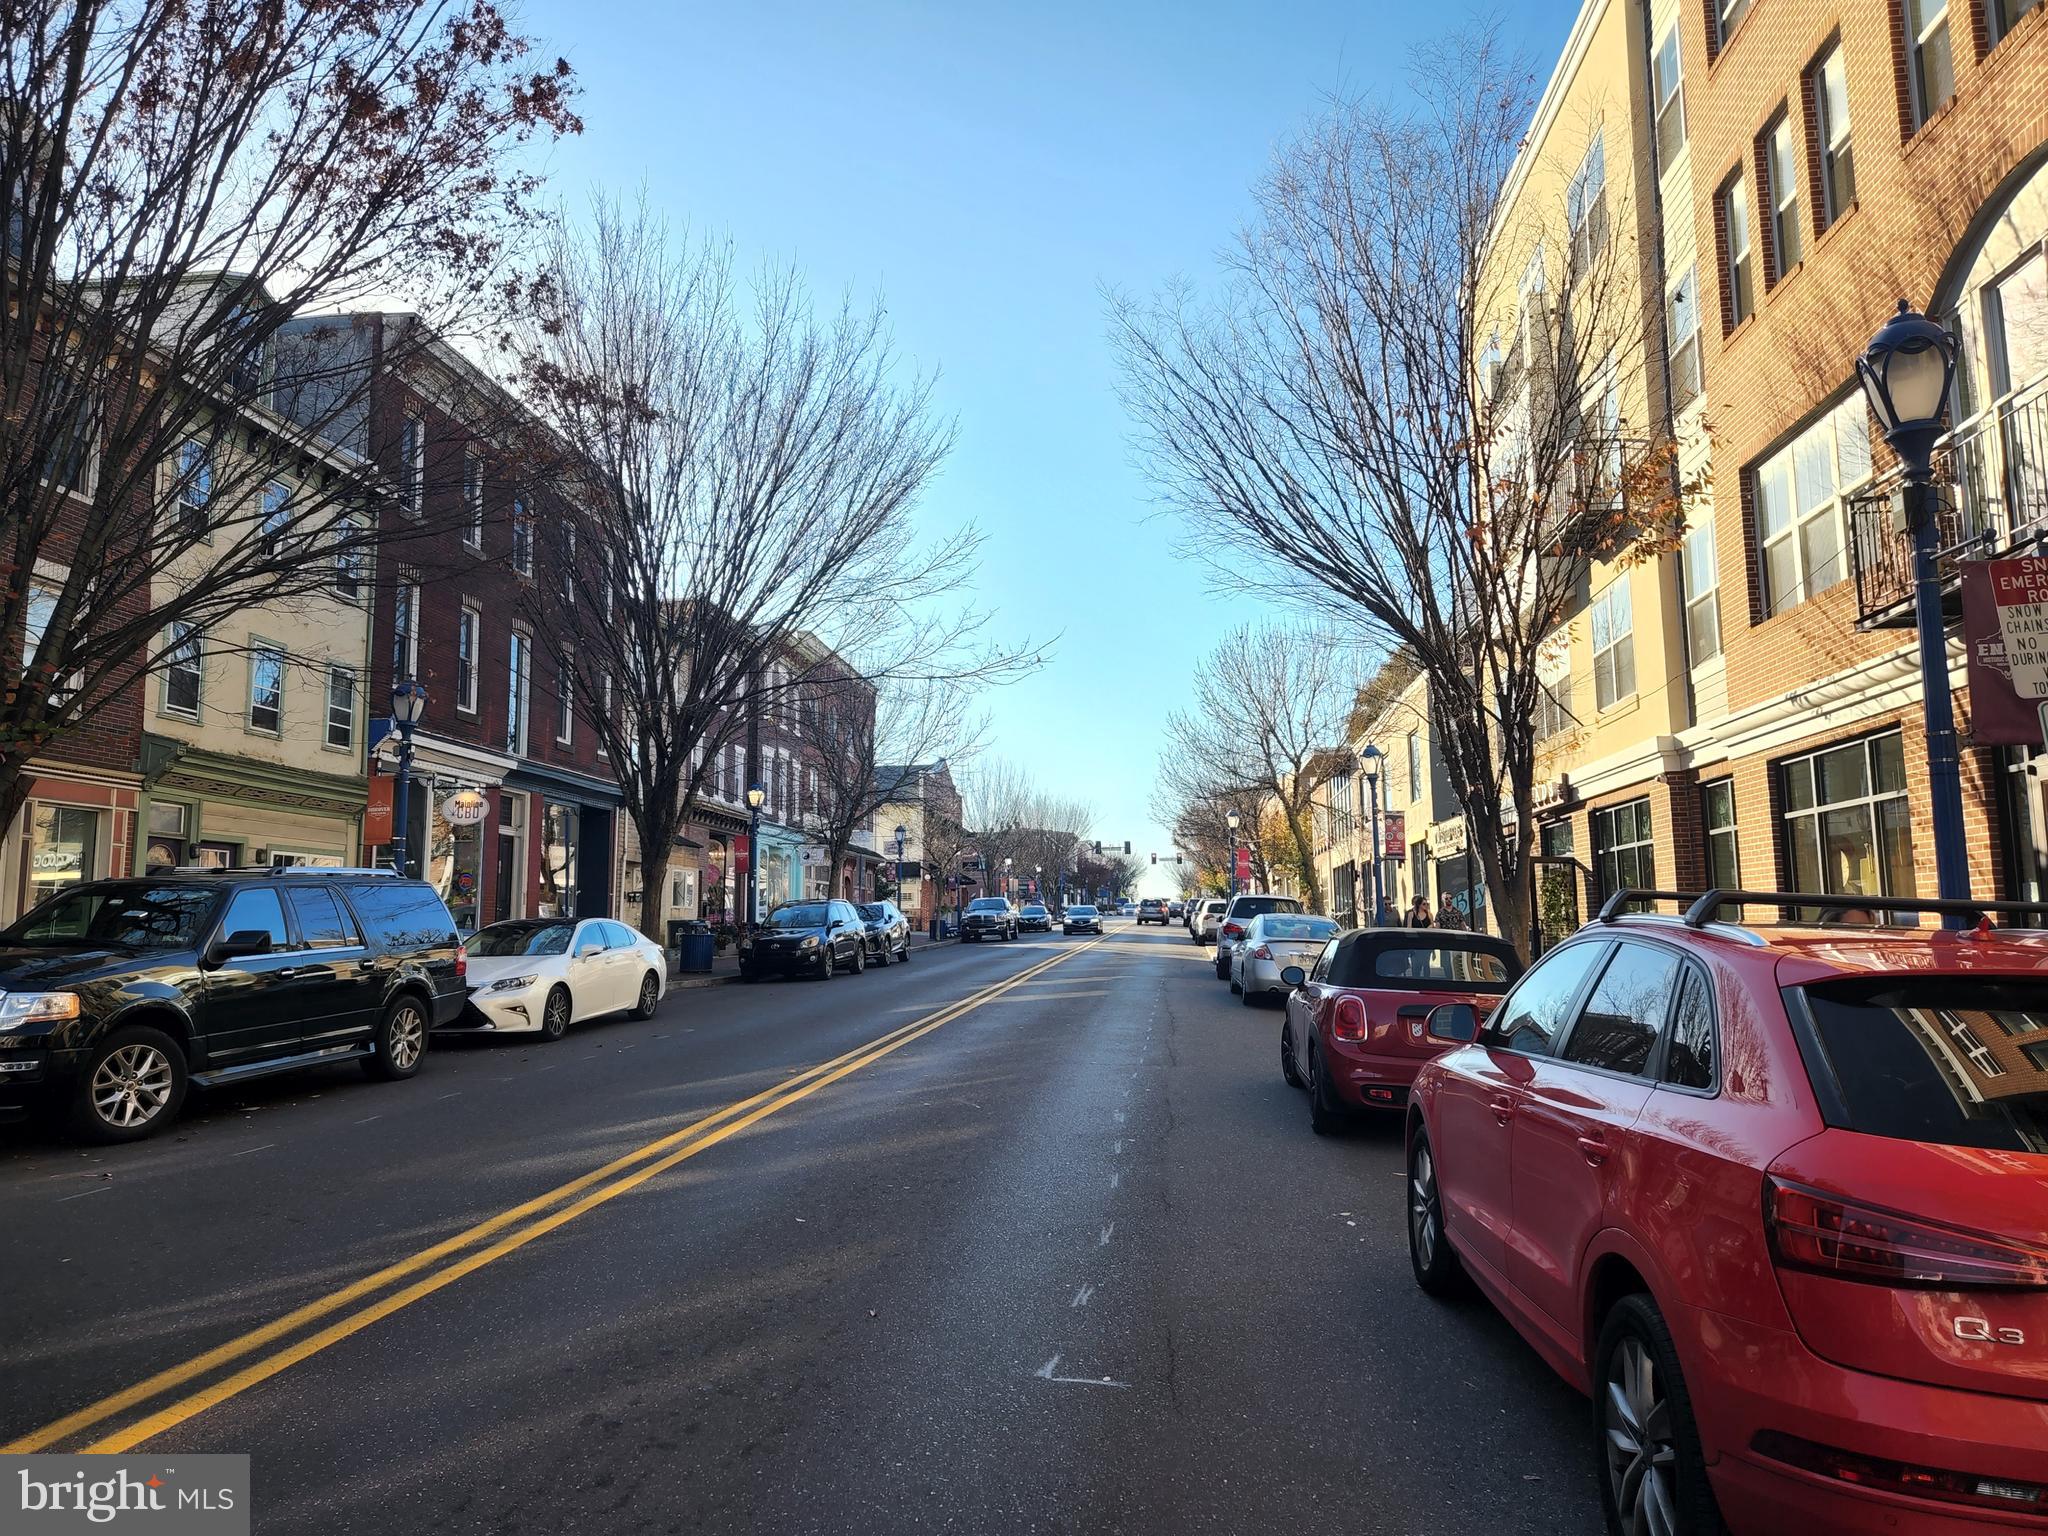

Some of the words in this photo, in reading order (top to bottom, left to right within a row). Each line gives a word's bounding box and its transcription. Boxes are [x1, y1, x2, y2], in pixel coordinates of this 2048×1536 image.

[2000, 573, 2048, 590] EMER
[2007, 603, 2042, 619] SNOW
[1977, 643, 2006, 657] EN
[2016, 637, 2037, 651] NO
[2011, 650, 2048, 666] DURIN
[457, 806, 480, 819] CBD
[1954, 1316, 2025, 1345] Q3
